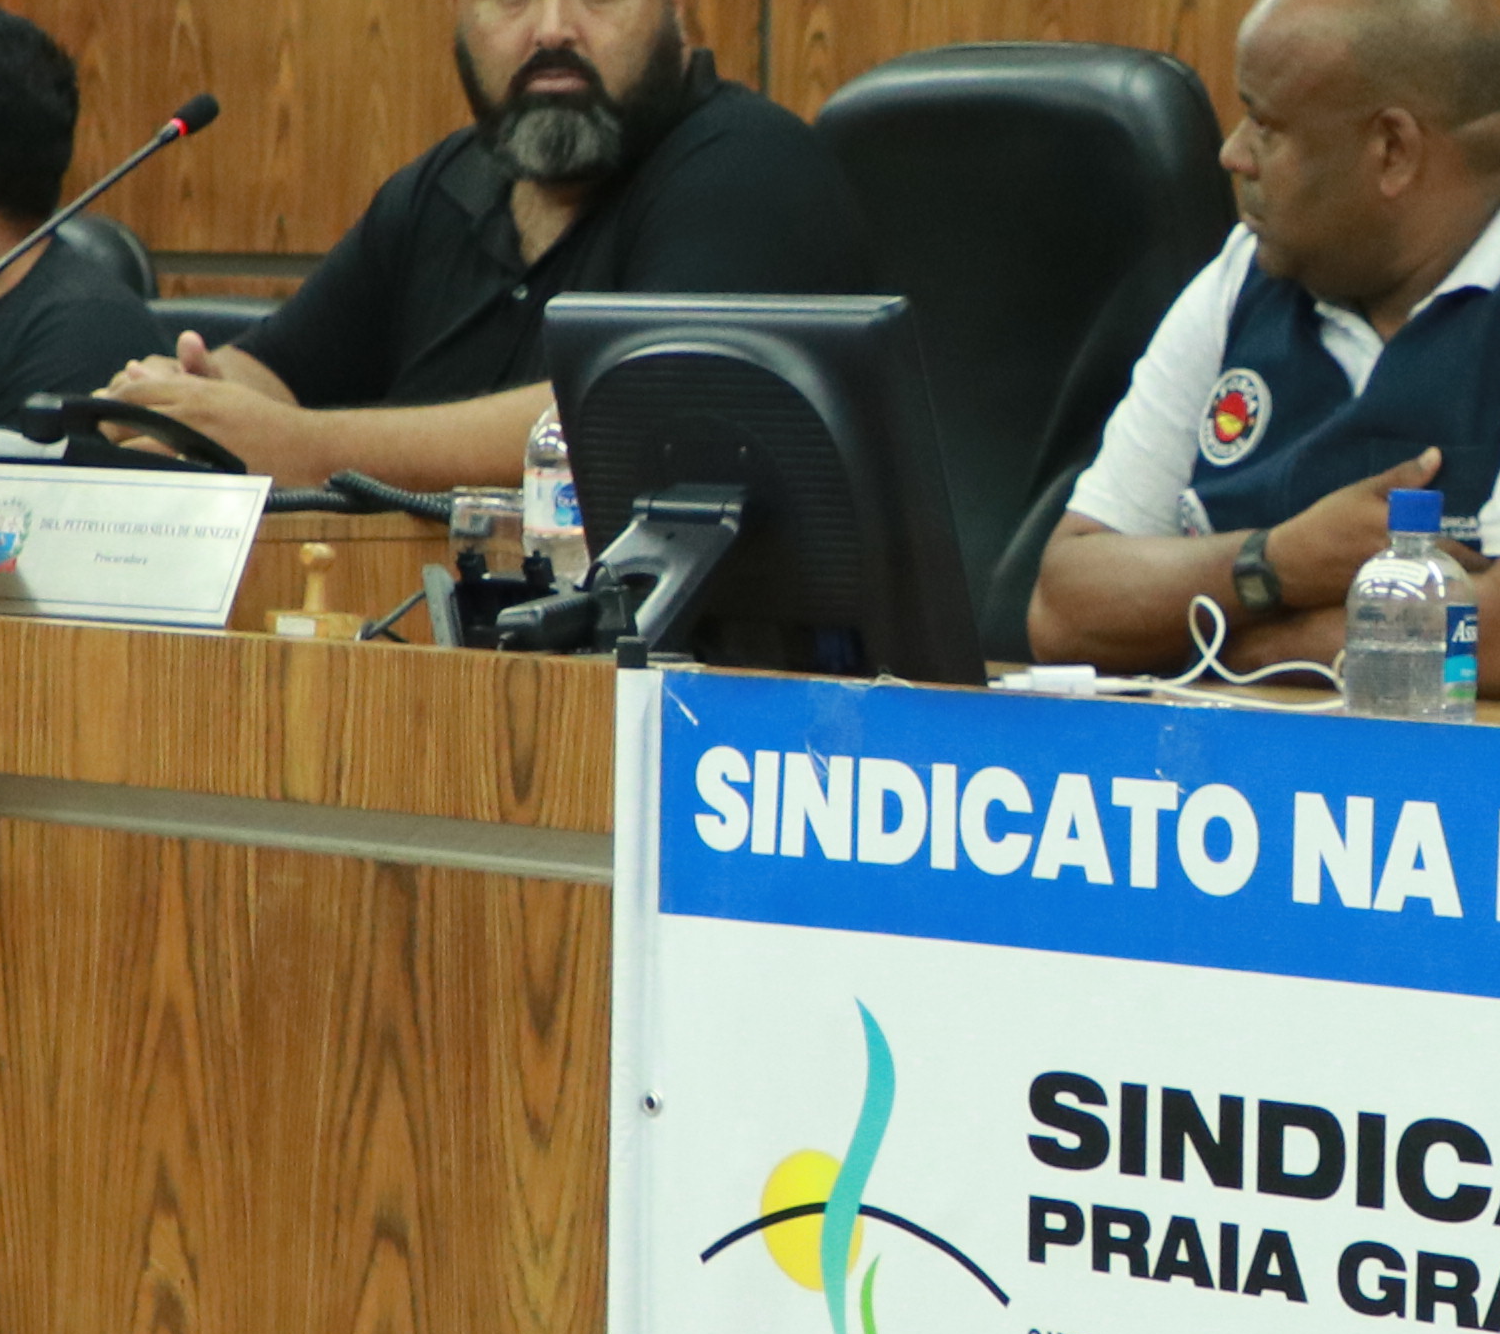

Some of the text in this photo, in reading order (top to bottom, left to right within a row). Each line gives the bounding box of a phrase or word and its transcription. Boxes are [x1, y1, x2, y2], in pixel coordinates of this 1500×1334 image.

[694, 745, 1260, 896] SINDICATO
[1292, 791, 1463, 918] NA
[1027, 1194, 1308, 1304] PRAIA
